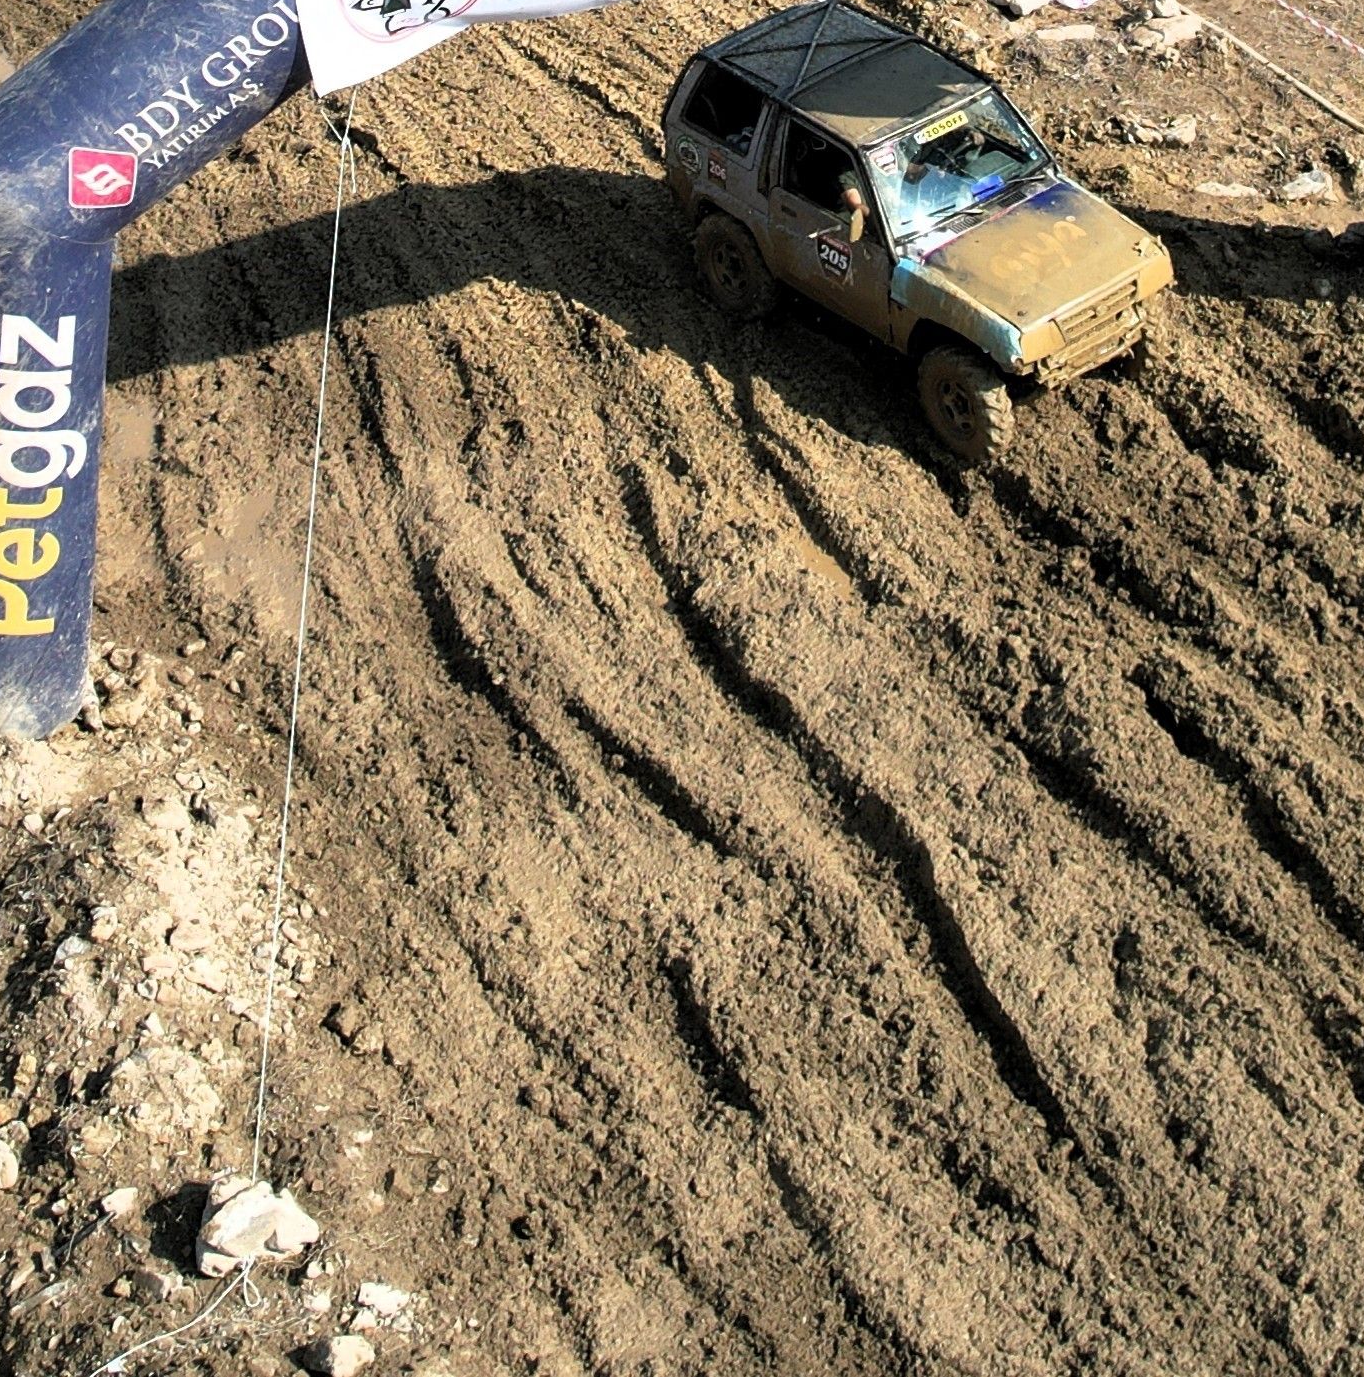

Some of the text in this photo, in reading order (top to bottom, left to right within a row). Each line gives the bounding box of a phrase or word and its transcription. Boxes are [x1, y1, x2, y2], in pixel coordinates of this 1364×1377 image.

[114, 76, 204, 157] BDY
[141, 104, 230, 170] YATIRIM
[819, 244, 848, 270] 205
